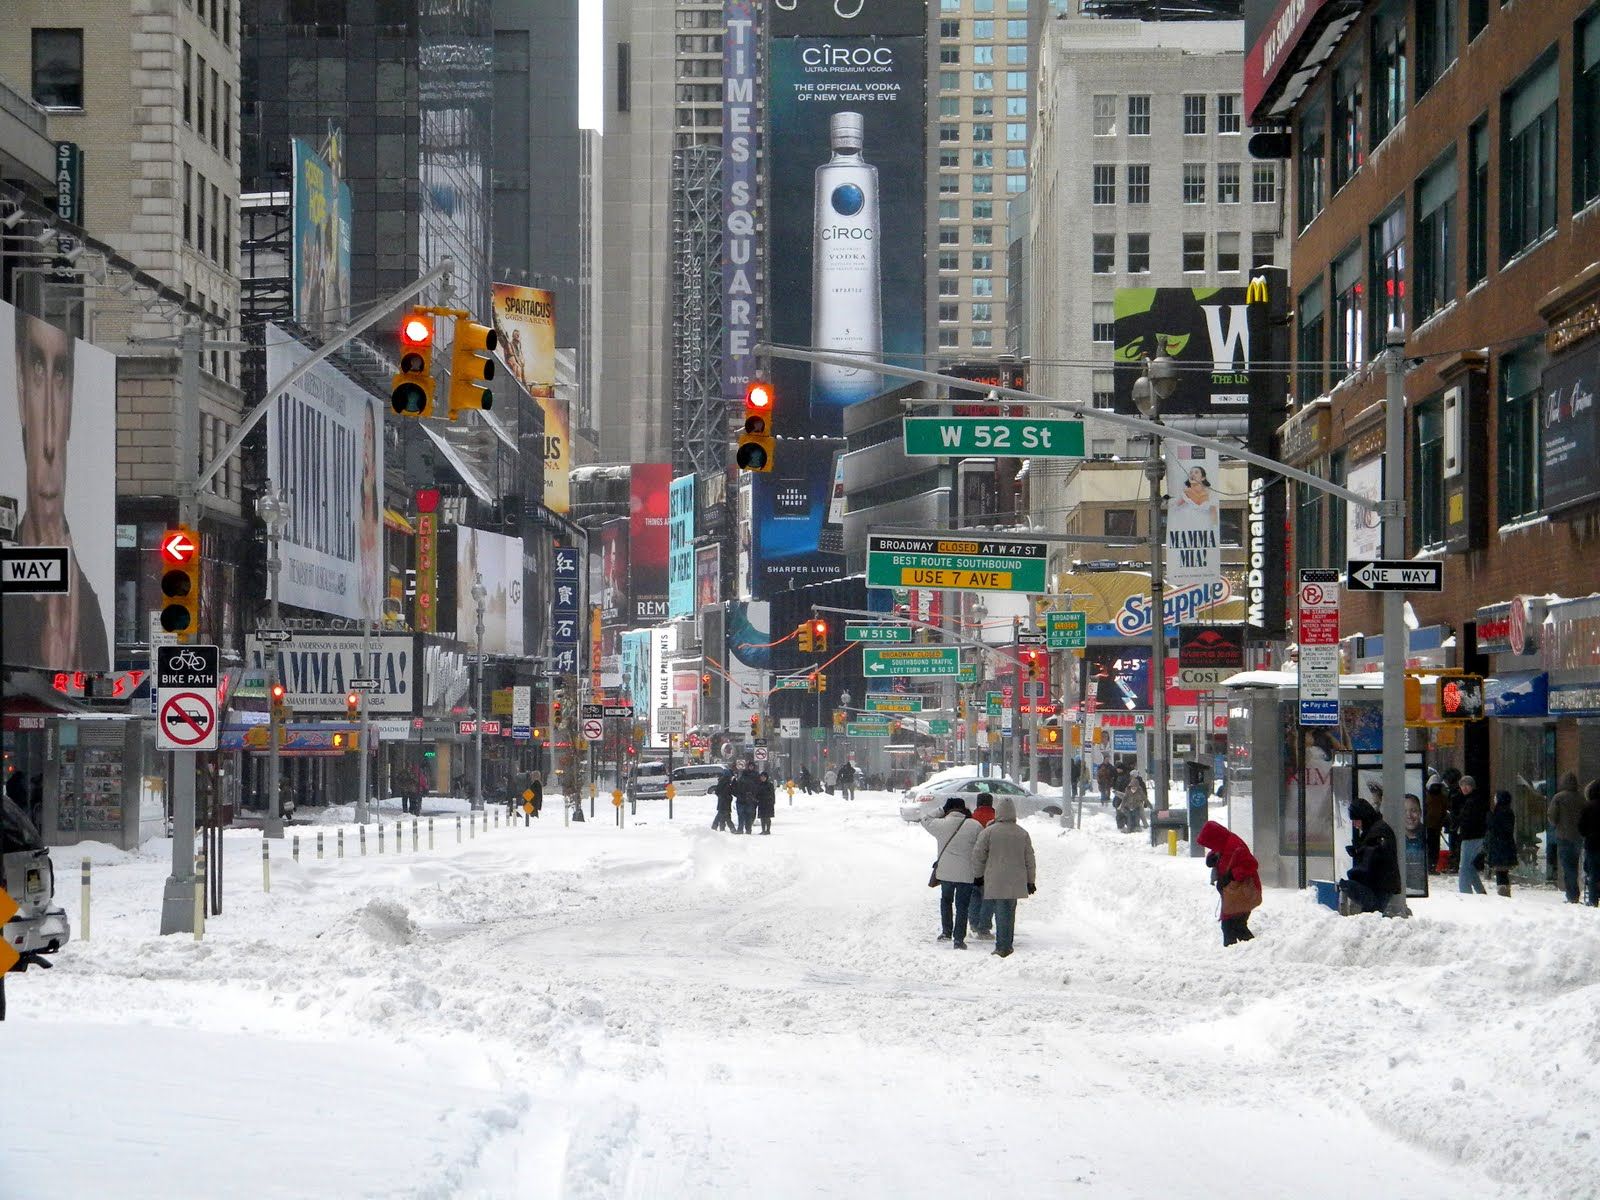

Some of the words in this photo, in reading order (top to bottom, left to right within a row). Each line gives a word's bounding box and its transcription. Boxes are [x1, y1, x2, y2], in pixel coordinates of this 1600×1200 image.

[802, 44, 892, 65] CÎROC
[727, 20, 753, 162] TIMES
[58, 145, 72, 254] STARBUS
[822, 225, 872, 240] CÎROC
[727, 180, 754, 355] SQUARE
[504, 296, 551, 318] SPARTACUS
[1211, 374, 1232, 384] THE
[940, 426, 962, 446] W
[974, 426, 1010, 448] 52
[1022, 426, 1052, 448] St
[646, 518, 662, 526] THINGS
[880, 540, 933, 551] BROADWAY
[939, 542, 977, 552] CLOSED
[983, 544, 995, 553] AT
[999, 545, 1008, 554] W
[1010, 545, 1022, 554] 47
[1025, 546, 1036, 555] ST
[1169, 530, 1216, 548] MAMMA
[893, 556, 917, 566] BEST
[921, 557, 952, 568] ROUTE
[957, 559, 1022, 569] SOUTHBOUND
[1180, 549, 1208, 568] MIA!
[11, 562, 52, 579] WAY
[914, 571, 943, 583] USE
[953, 572, 962, 584] 7
[969, 573, 999, 586] AVE
[1362, 570, 1388, 582] ONE
[1402, 571, 1430, 582] WAY
[509, 580, 521, 604] UGG
[1122, 582, 1224, 630] Sapple
[162, 675, 184, 684] BIKE
[189, 675, 213, 684] PATH
[1182, 670, 1218, 683] Così
[461, 722, 498, 732] FAMIA
